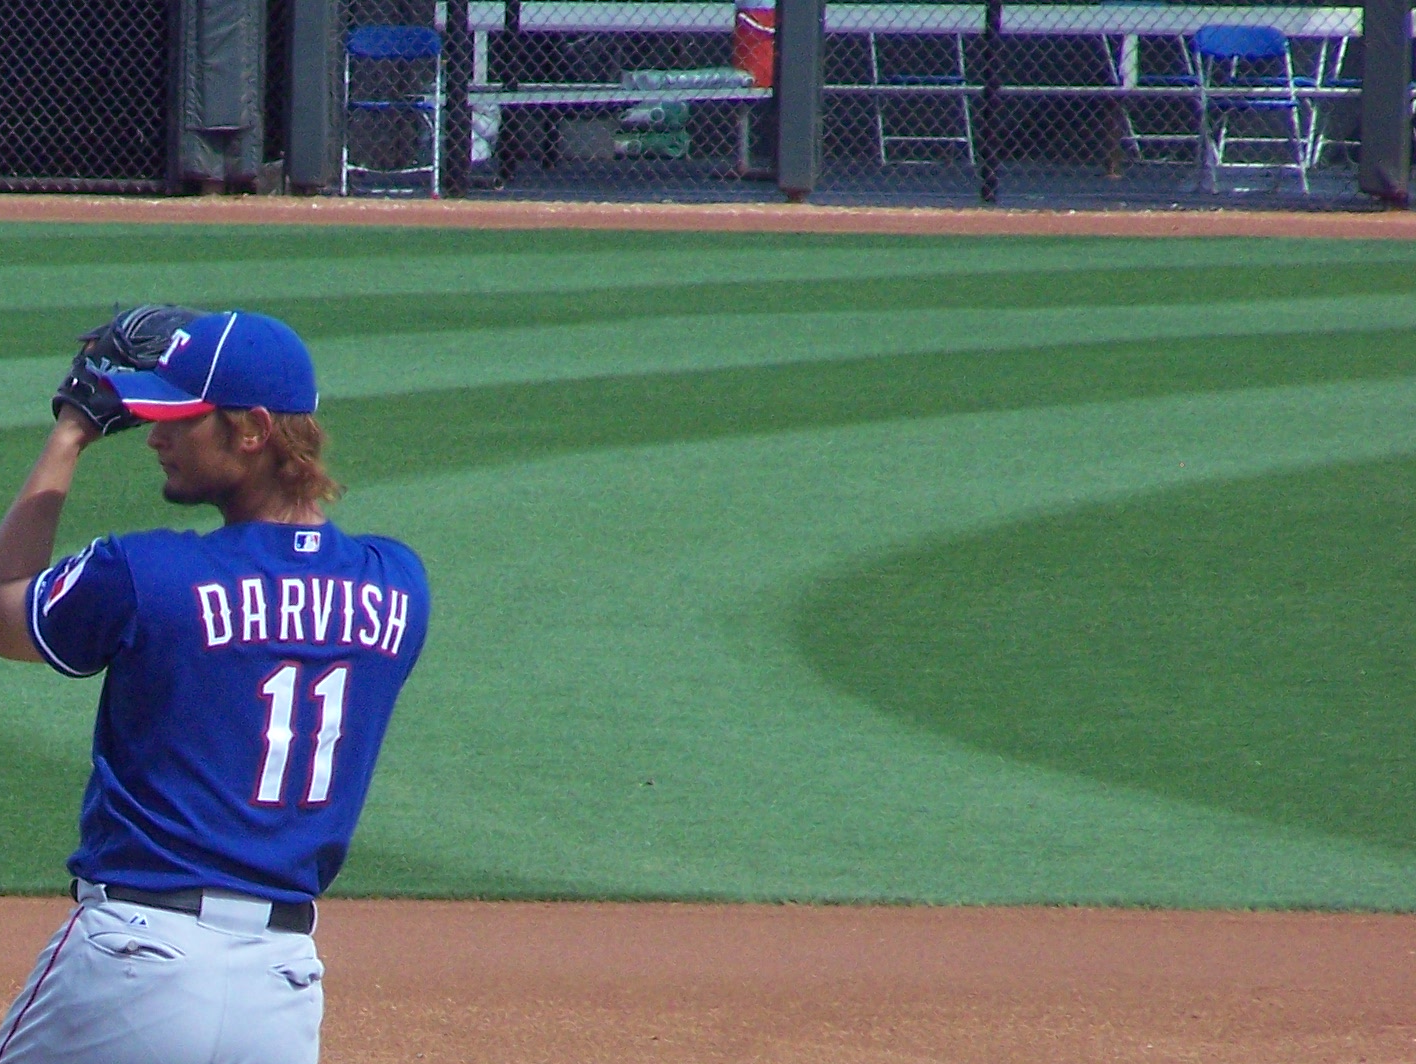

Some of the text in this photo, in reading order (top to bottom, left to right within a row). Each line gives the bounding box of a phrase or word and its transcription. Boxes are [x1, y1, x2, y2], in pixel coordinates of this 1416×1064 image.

[158, 328, 191, 367] T
[196, 576, 410, 655] DARVISH
[254, 664, 349, 804] 11
